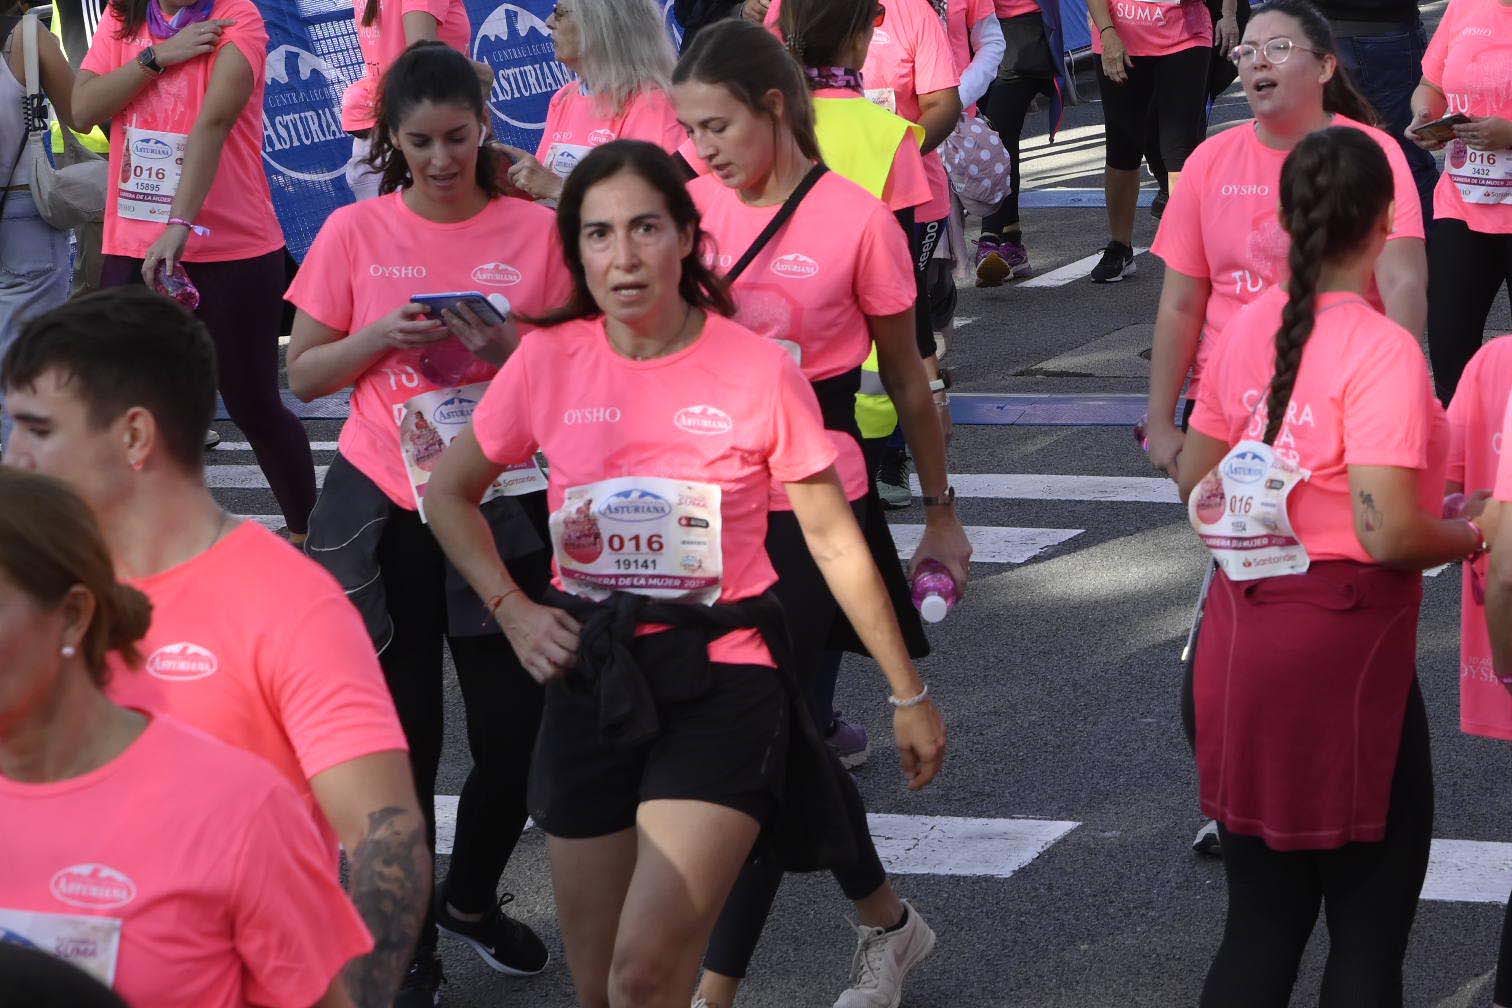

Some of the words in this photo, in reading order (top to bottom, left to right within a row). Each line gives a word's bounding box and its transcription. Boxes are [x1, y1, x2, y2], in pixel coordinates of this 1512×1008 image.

[1117, 2, 1165, 21] SUMA
[493, 45, 527, 62] CENTRAL
[1448, 92, 1470, 114] TU
[1469, 152, 1496, 166] 016
[134, 165, 166, 180] 016
[1472, 168, 1490, 176] 3432
[136, 182, 160, 192] 15895
[1222, 184, 1269, 196] OYSHO
[369, 263, 427, 279] OYSHO
[1232, 269, 1262, 295] TU
[564, 406, 622, 426] OYSHO
[604, 501, 667, 516] ASTURIANA
[1230, 496, 1254, 514] 016
[608, 533, 665, 552] 016
[614, 558, 658, 570] 19141
[1252, 553, 1297, 567] Santander
[618, 577, 632, 586] DE
[633, 577, 646, 586] LA
[648, 578, 682, 587] MUJER
